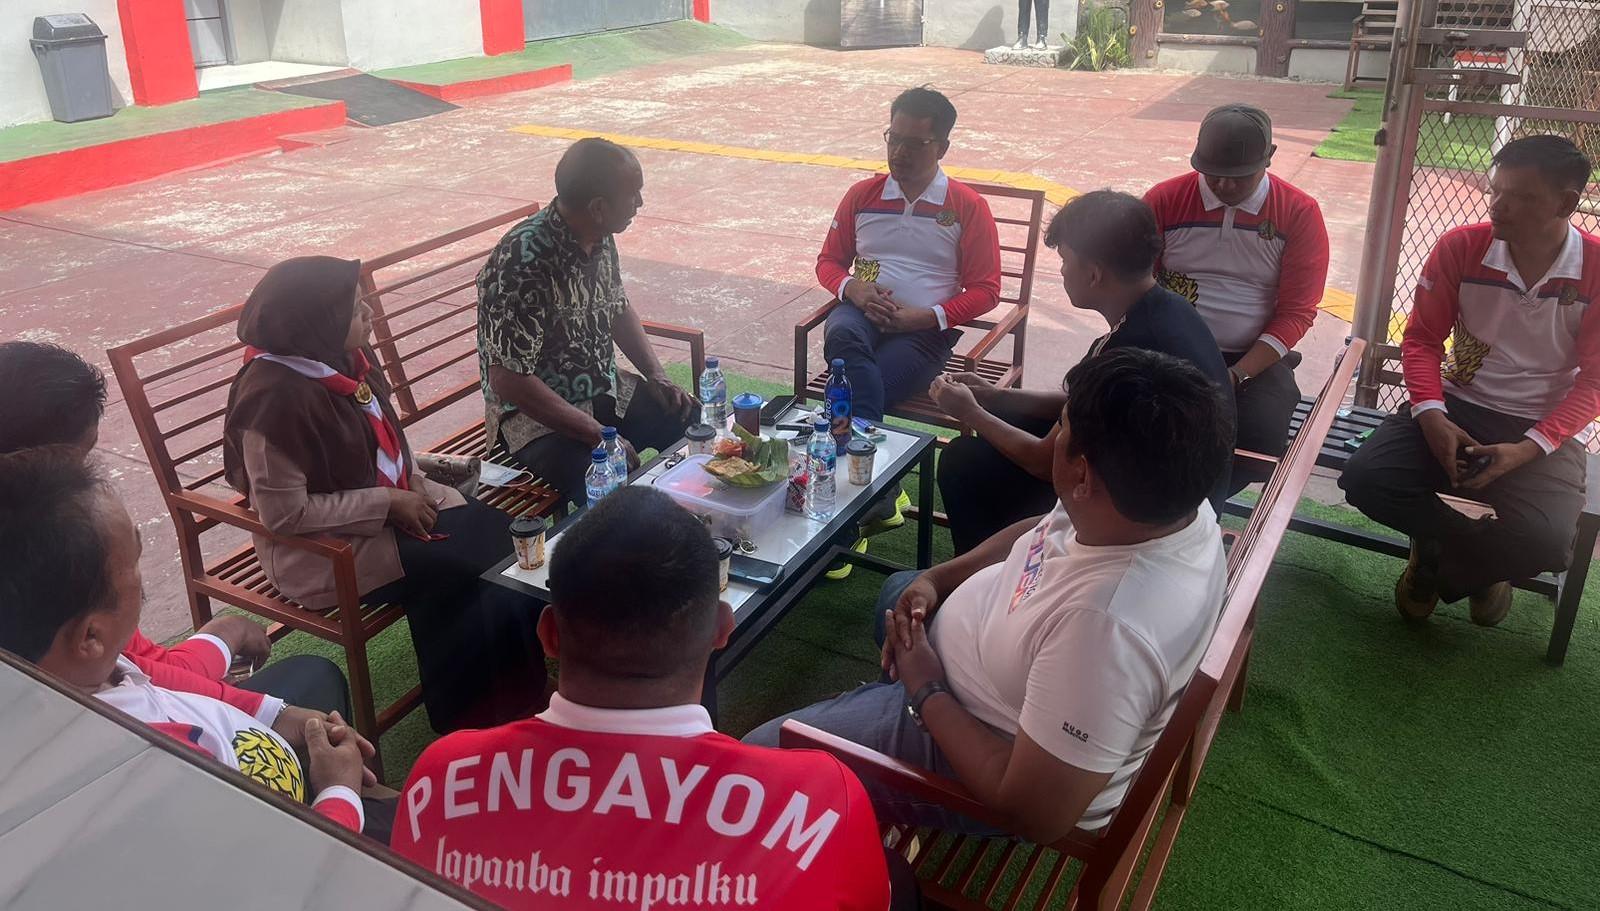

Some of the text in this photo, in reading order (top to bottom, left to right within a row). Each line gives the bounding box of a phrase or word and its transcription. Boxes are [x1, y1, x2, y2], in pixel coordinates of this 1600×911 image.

[1063, 721, 1089, 740] HUGO
[406, 747, 841, 871] PENGAYOM
[436, 835, 759, 911] lapanba impalku
